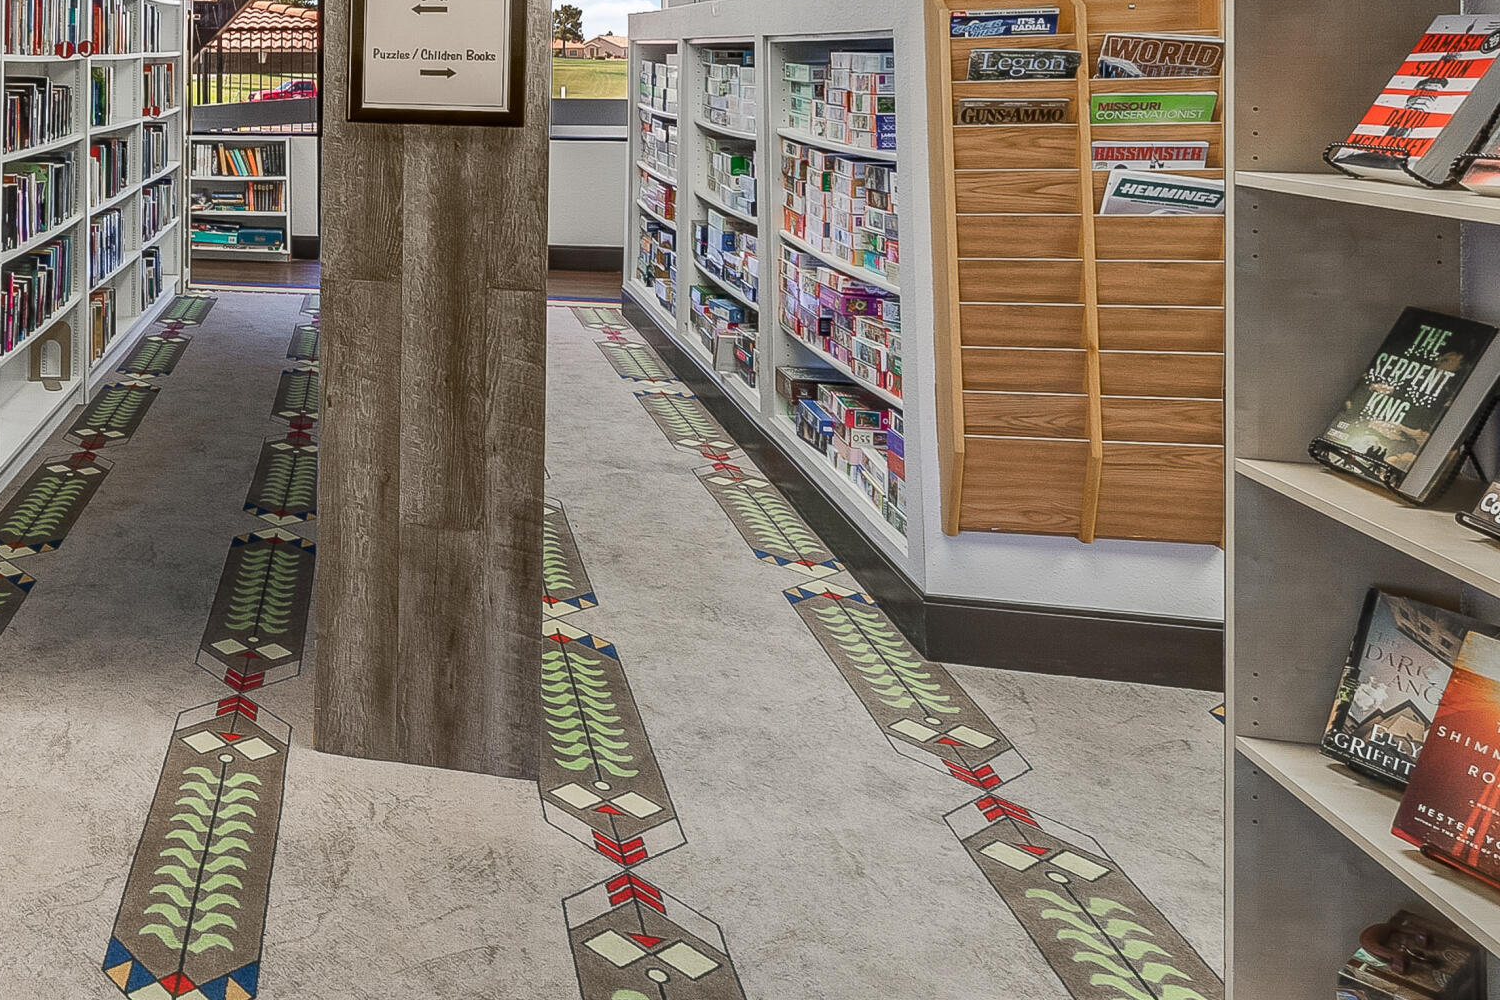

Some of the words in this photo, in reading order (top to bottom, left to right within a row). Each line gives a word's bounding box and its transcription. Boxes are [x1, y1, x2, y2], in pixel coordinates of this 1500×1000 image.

[1011, 24, 1050, 32] RADIAL!
[81, 42, 91, 57] J
[373, 48, 410, 60] Puzzles
[411, 48, 419, 60] /
[420, 49, 463, 61] Children
[466, 49, 496, 61] Books
[1109, 37, 1221, 68] WORLD
[1419, 34, 1492, 52] DAMASC
[979, 51, 1066, 77] Legion
[1411, 60, 1474, 78] STATION
[1095, 109, 1205, 120] CONSERVATIONIST
[1098, 102, 1162, 111] MISSOURI
[1384, 109, 1430, 128] DAVID
[1094, 146, 1203, 161] BASSMASTER
[1119, 183, 1220, 203] HEMMINGS
[1404, 325, 1452, 360] THE
[1365, 353, 1455, 407] SERPENT
[1360, 392, 1411, 427] KING
[1481, 493, 1500, 524] Co
[1365, 643, 1430, 680] DARK
[1387, 674, 1445, 706] ANG
[1369, 723, 1423, 758] ELLY
[1333, 732, 1417, 776] GRIFFIT
[1467, 765, 1500, 788] RO
[1417, 803, 1476, 837] HESTER
